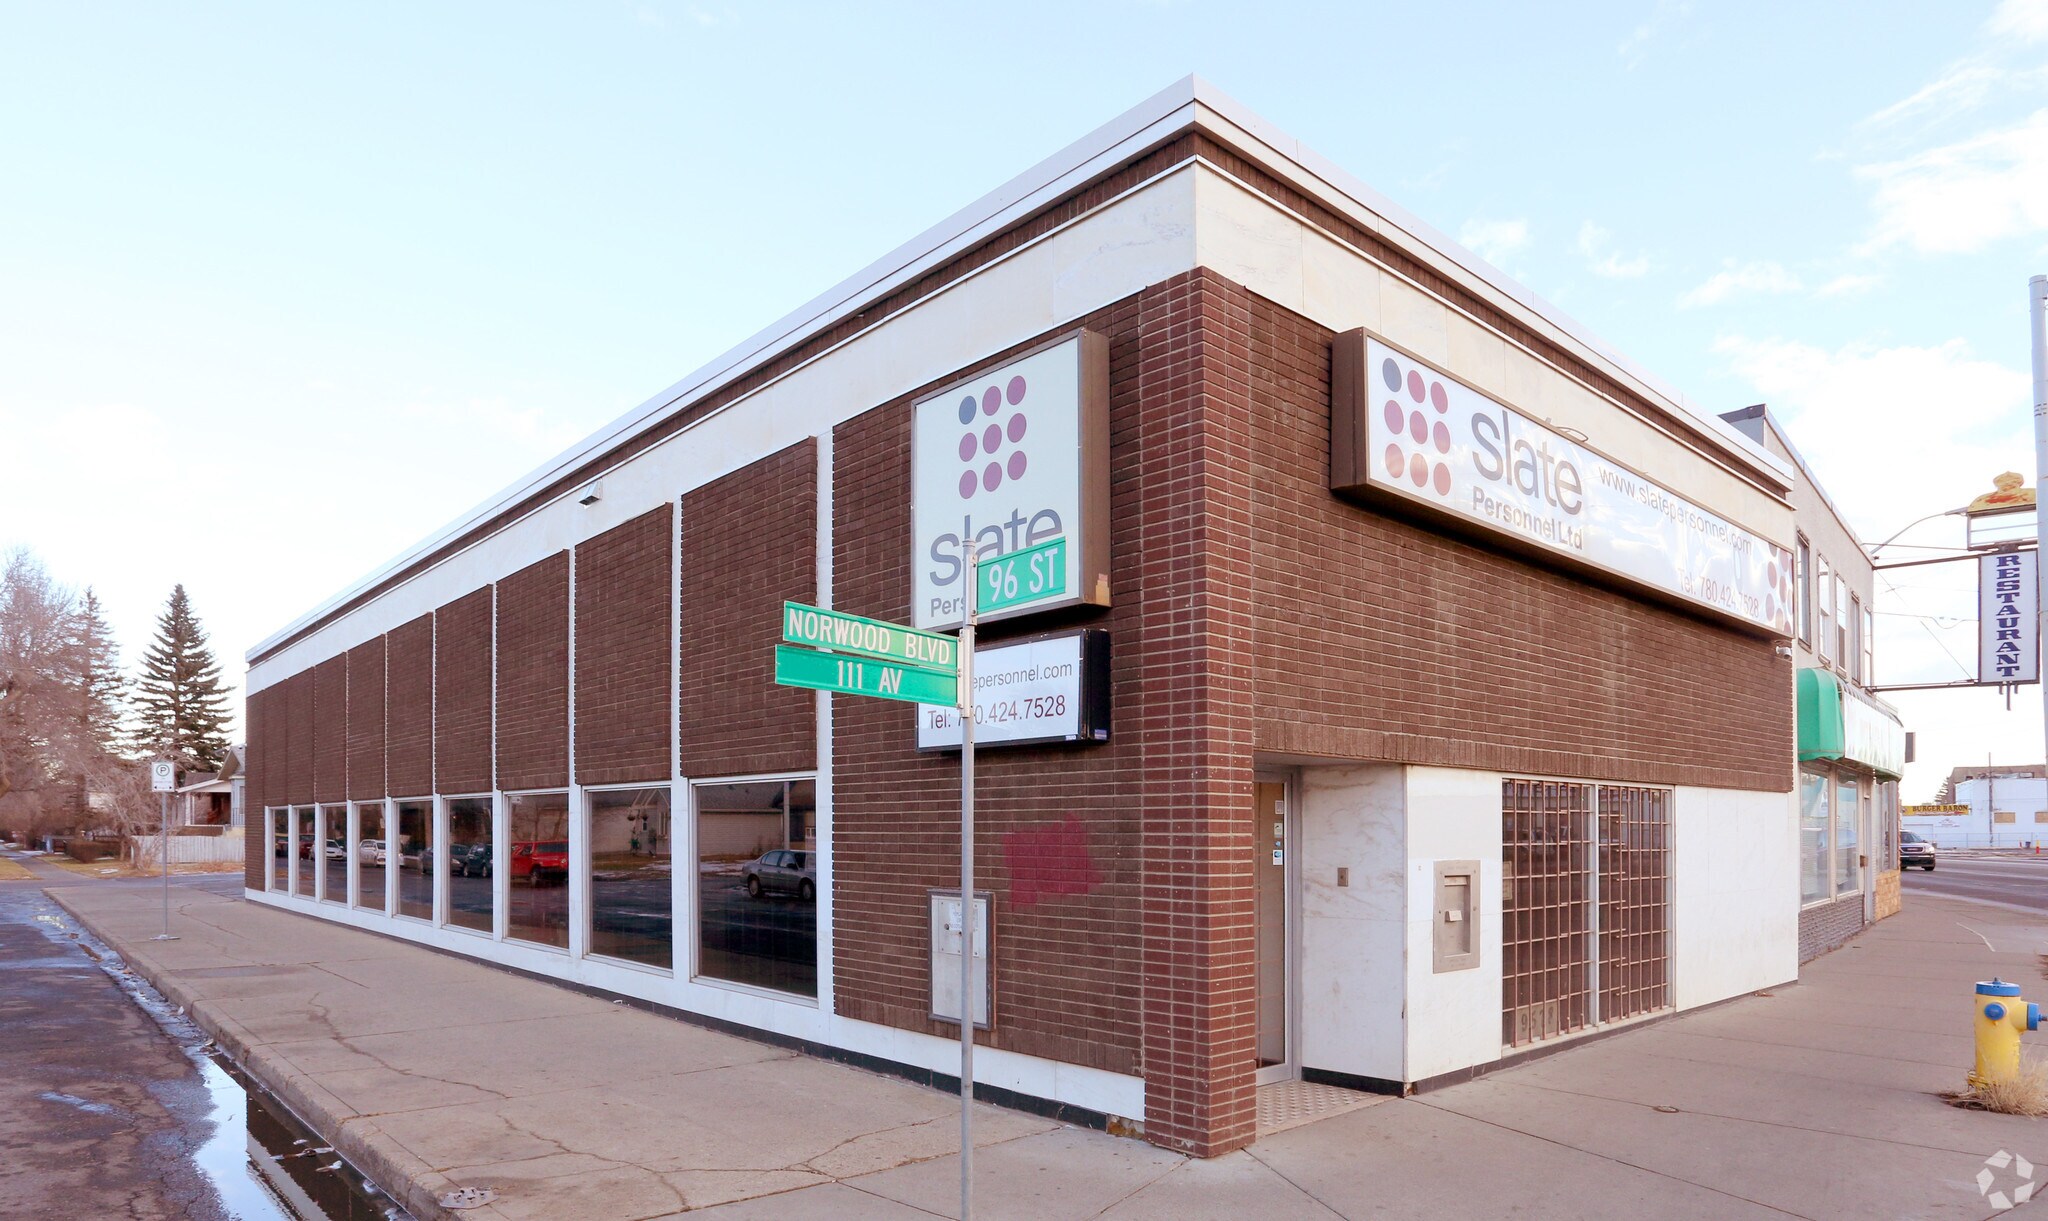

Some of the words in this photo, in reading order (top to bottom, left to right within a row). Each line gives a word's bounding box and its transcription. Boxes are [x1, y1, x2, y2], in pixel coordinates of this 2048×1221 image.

[1471, 409, 1582, 515] slate
[1473, 485, 1555, 540] Personnel
[1559, 520, 1582, 550] Ltd
[1599, 466, 1752, 555] www.slatepersonnel.com
[989, 560, 1018, 602] 96
[1029, 547, 1058, 593] ST
[788, 608, 890, 653] NORWOOD
[905, 632, 950, 664] BLVD
[1996, 555, 2021, 678] RESTAURANT
[837, 660, 863, 689] 111
[878, 667, 902, 694] AV
[973, 663, 1072, 692] epersonnel.com
[928, 709, 951, 729] Tel:
[958, 694, 1066, 727] 0.424.7528
[1912, 804, 1942, 812] BURGER
[1943, 804, 1969, 812] BARON
